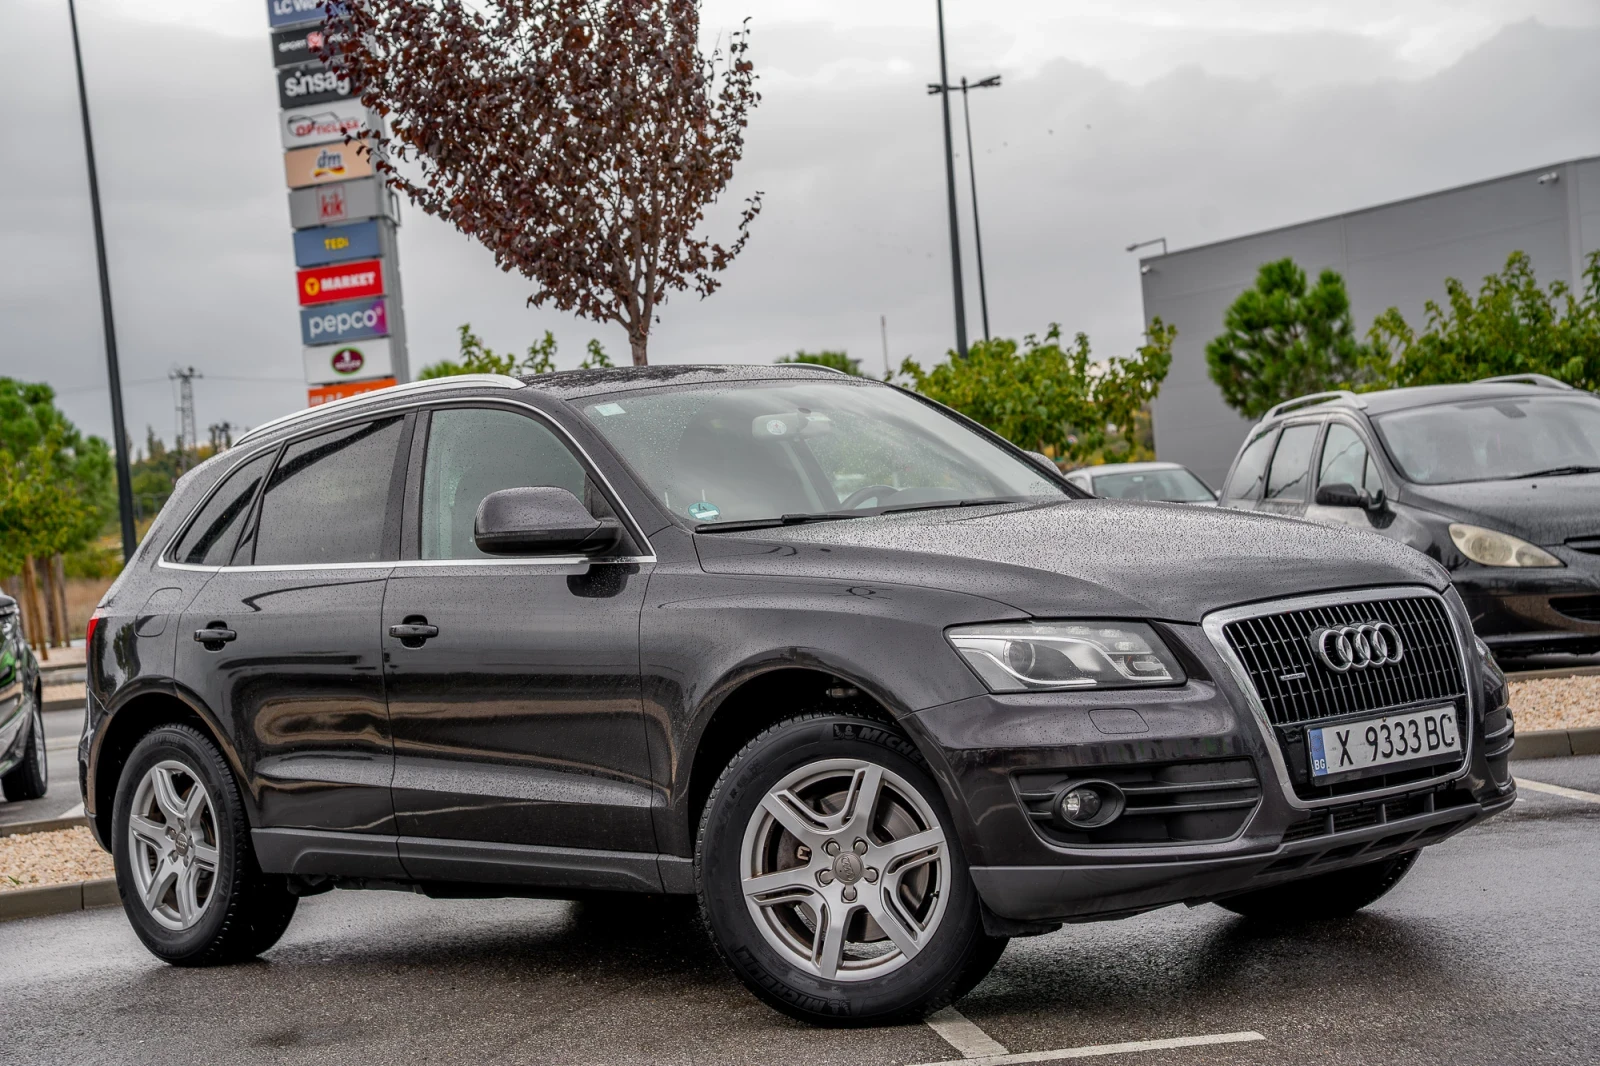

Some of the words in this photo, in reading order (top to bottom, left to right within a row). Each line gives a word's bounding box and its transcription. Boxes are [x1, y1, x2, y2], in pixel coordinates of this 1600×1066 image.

[317, 149, 342, 168] dm
[320, 271, 376, 292] MARKET
[308, 309, 378, 339] pepco
[1335, 729, 1354, 767] X
[1365, 718, 1422, 762] 9333
[1424, 713, 1455, 751] BC
[1314, 758, 1326, 771] BG
